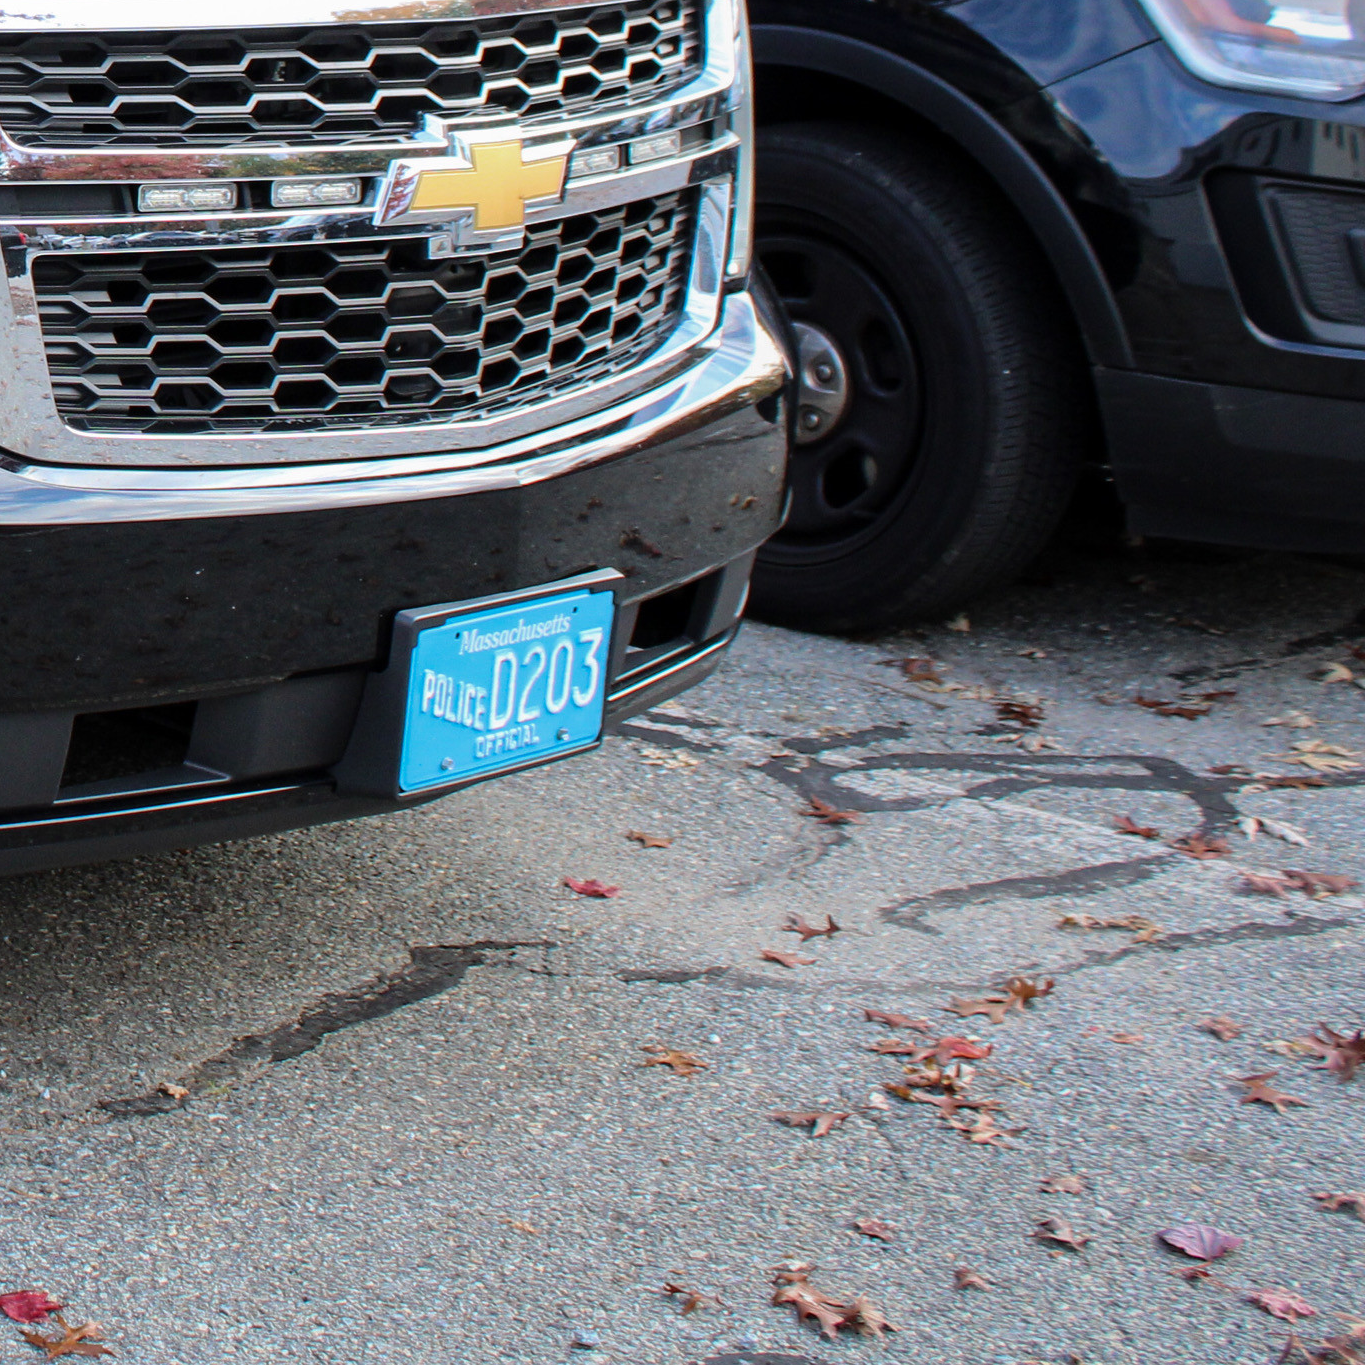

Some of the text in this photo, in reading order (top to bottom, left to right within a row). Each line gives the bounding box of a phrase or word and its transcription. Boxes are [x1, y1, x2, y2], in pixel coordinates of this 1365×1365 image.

[459, 613, 571, 655] Massachusetts
[421, 627, 604, 731] POLICE D203
[474, 723, 540, 758] OFFICIAL
